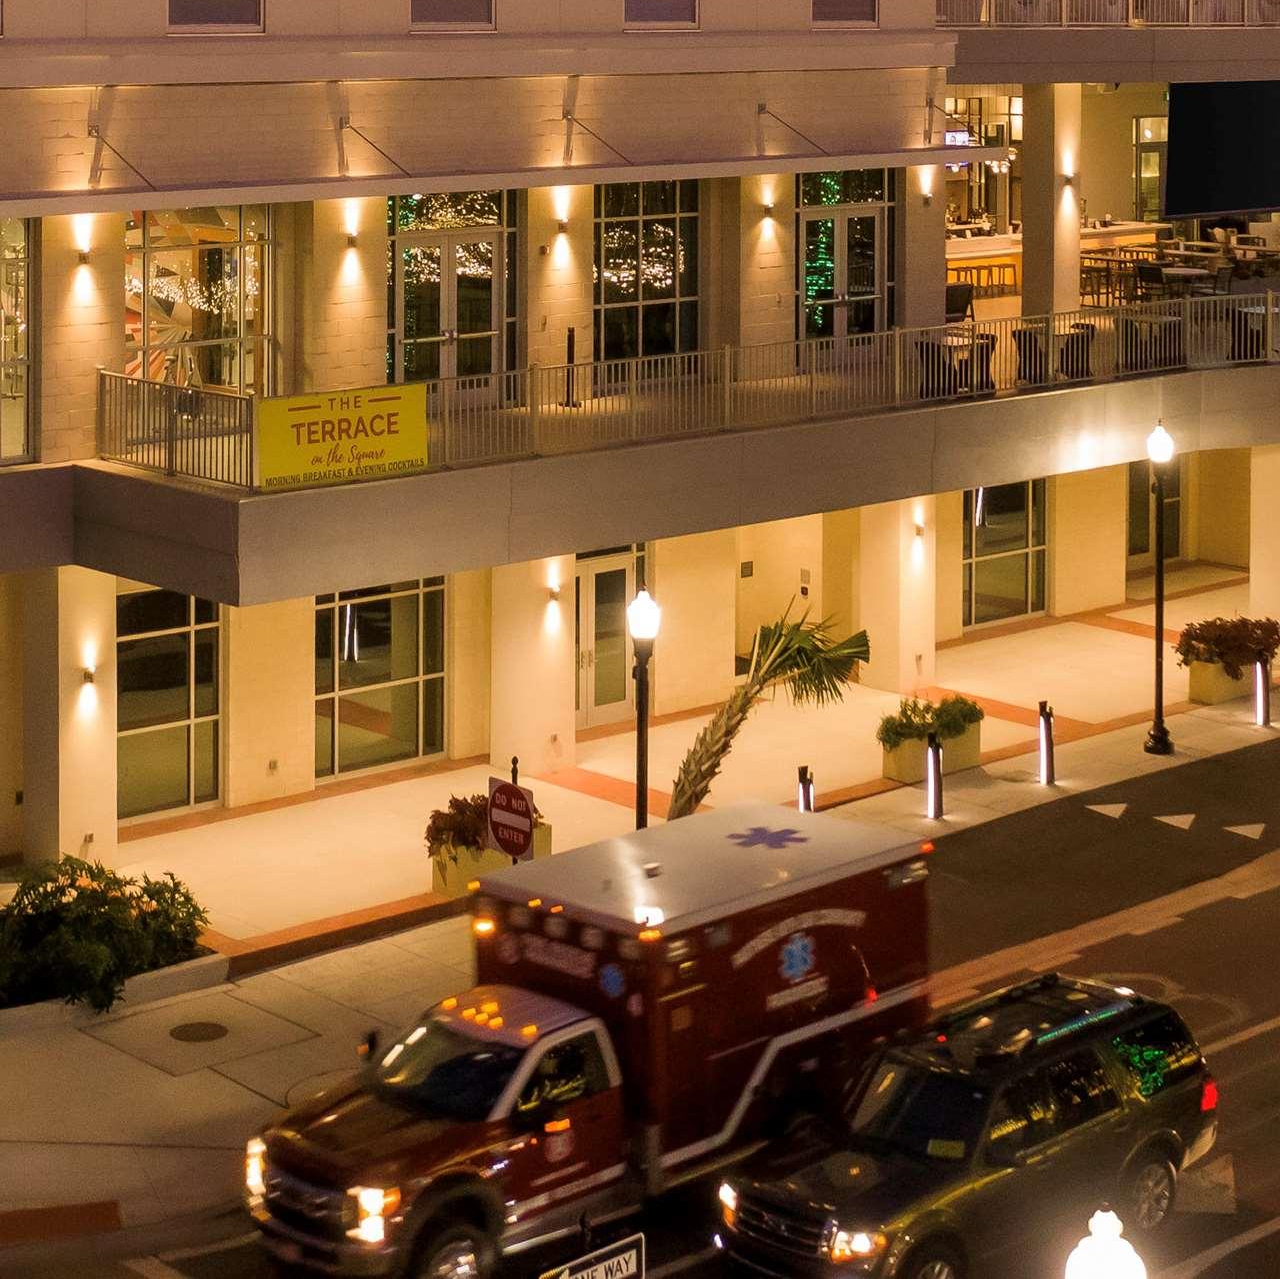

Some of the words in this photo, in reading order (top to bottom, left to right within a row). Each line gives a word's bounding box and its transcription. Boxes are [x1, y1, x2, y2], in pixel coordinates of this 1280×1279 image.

[328, 395, 362, 411] THE
[291, 412, 400, 446] TERRACE
[311, 456, 323, 466] on
[327, 442, 343, 466] the
[348, 444, 385, 466] Square
[265, 474, 300, 488] MORNING
[303, 468, 345, 481] BREAKFAST
[347, 467, 353, 477] &
[355, 463, 386, 475] EVENING
[388, 457, 424, 471] COCKTAILS
[495, 793, 507, 807] DO
[511, 796, 527, 812] NOT
[499, 826, 524, 845] ENTER
[604, 1253, 632, 1279] WAY
